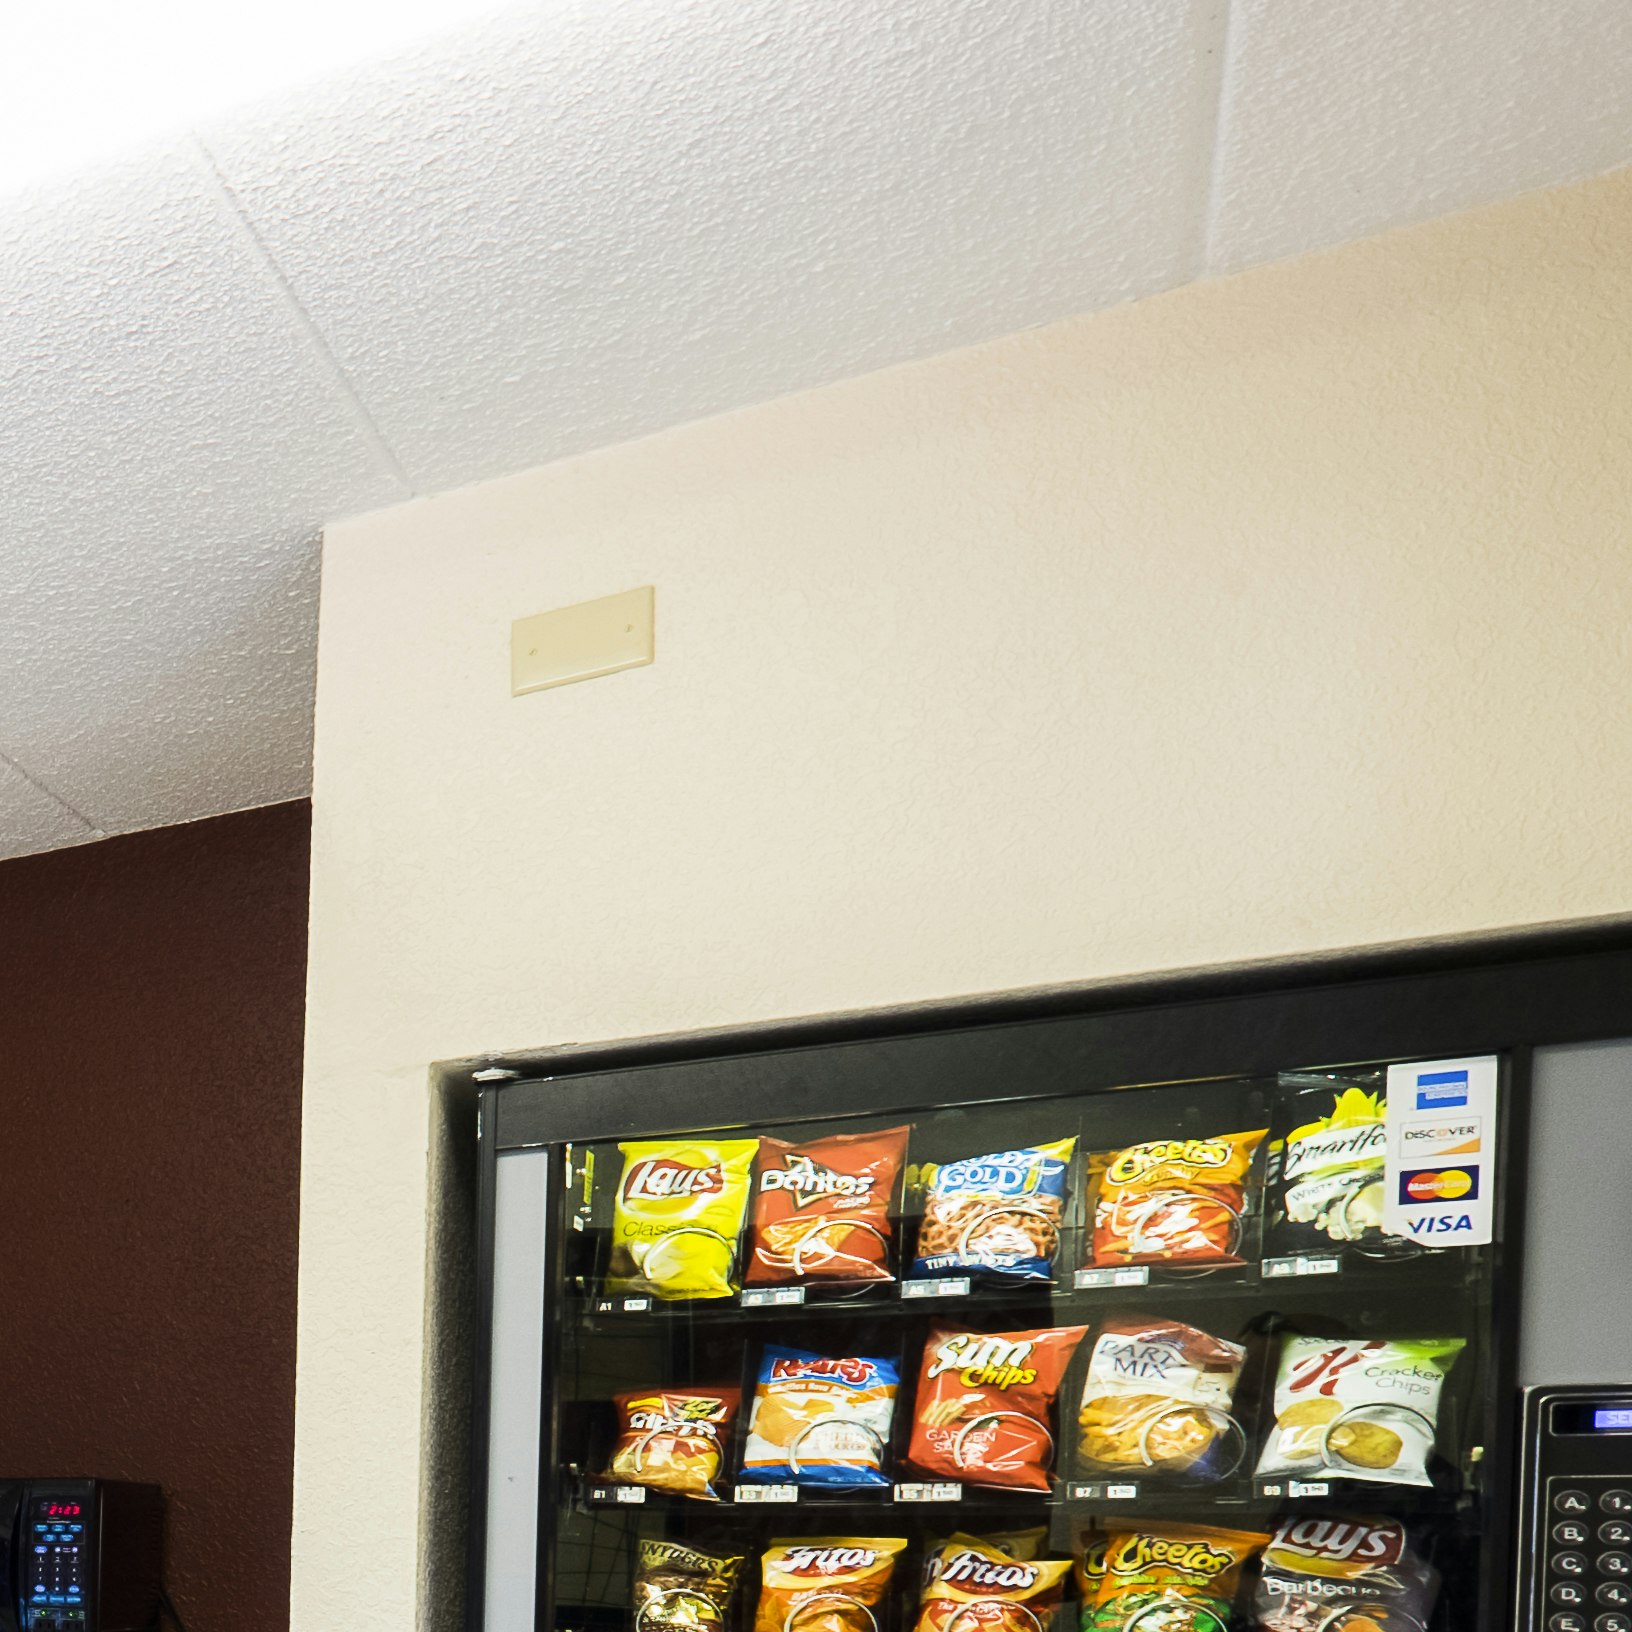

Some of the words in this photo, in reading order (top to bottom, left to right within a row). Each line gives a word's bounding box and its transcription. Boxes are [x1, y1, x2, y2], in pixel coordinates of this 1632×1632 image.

[1404, 1125, 1477, 1141] DISCOVER
[1284, 1123, 1388, 1178] Smartfo
[1106, 1138, 1233, 1186] Cheetos
[760, 1168, 876, 1197] Doritos
[939, 1163, 1024, 1191] GOLD
[1407, 1214, 1474, 1234] VISA
[925, 1256, 958, 1270] TINY
[927, 1333, 1034, 1379] Sun
[1100, 1339, 1179, 1368] PART
[959, 1362, 1038, 1391] Chips
[1113, 1356, 1169, 1381] MIX
[1374, 1377, 1432, 1397] Chips
[1564, 1496, 1579, 1508] A
[1563, 1527, 1578, 1539] B
[1610, 1527, 1623, 1539] 2
[778, 1545, 881, 1574] Fritos
[1113, 1537, 1234, 1577] Cheetos
[1562, 1557, 1577, 1570] C
[1609, 1558, 1622, 1570] 3
[940, 1550, 1039, 1588] Fritos
[1561, 1587, 1576, 1600] D
[1607, 1587, 1619, 1600] 4
[1560, 1618, 1573, 1630] E
[1606, 1619, 1618, 1631] 5
